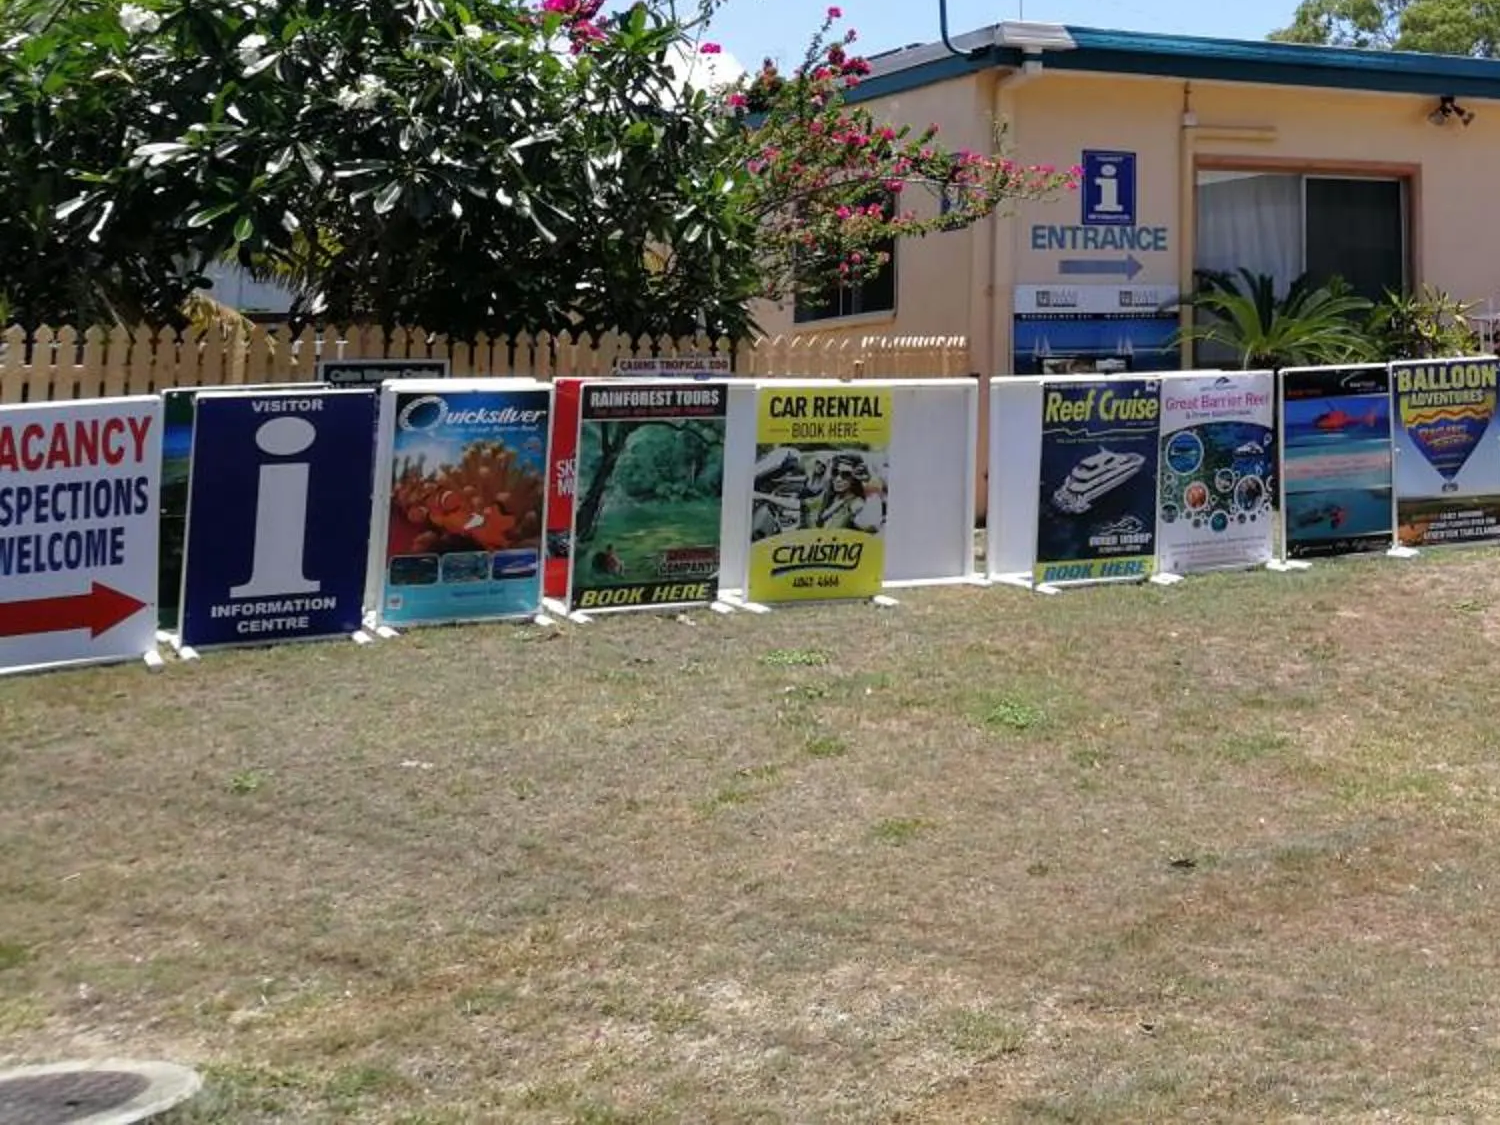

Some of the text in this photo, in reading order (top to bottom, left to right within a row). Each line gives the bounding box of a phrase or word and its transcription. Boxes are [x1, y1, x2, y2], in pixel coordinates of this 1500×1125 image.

[1031, 225, 1168, 251] ENTRANCE
[1396, 364, 1498, 393] BALLOON
[251, 398, 324, 413] VISITOR
[590, 389, 720, 408] RAINFOREST TOURS
[770, 396, 882, 418] CAR RENTAL
[1045, 389, 1159, 423] Reef Cruise
[1410, 392, 1484, 406] ADVENTURES
[399, 395, 547, 437] Quicksilver
[791, 421, 859, 438] BOOK HERE
[772, 537, 863, 570] cruising
[581, 583, 710, 607] BOOK HERE
[211, 597, 336, 618] INFORMATION
[237, 617, 308, 633] CENTRE
